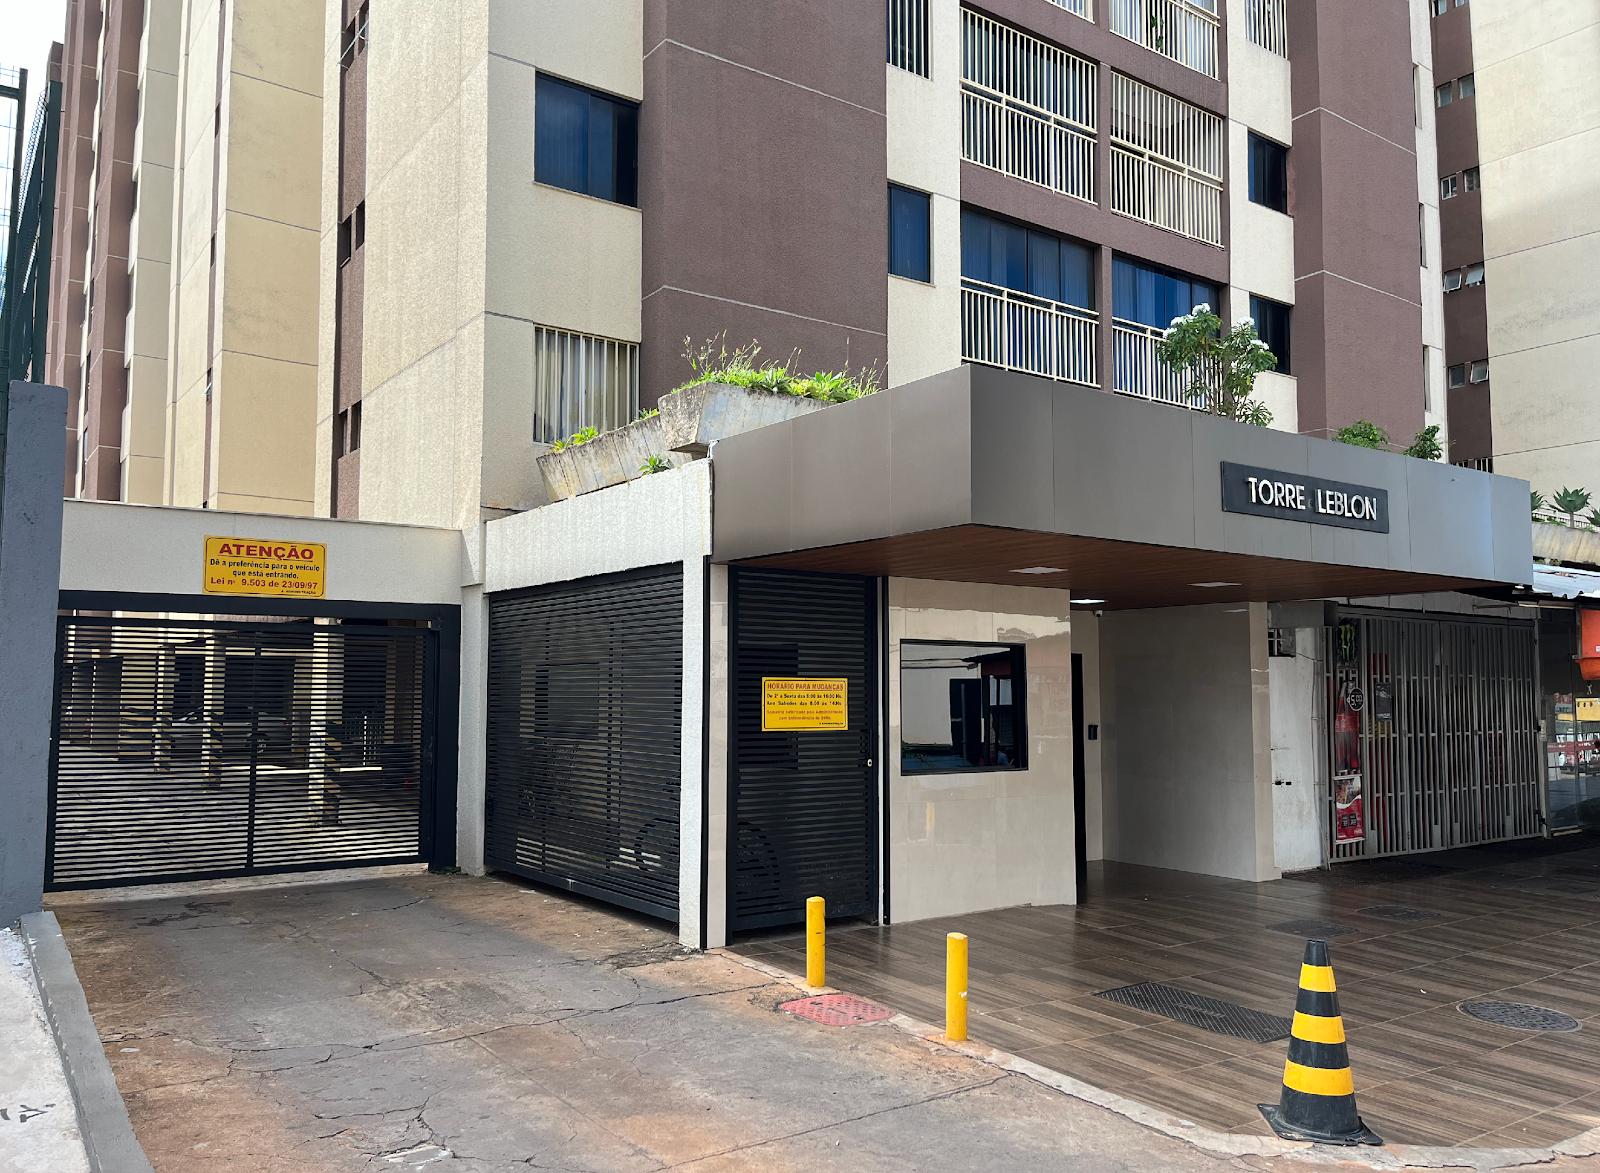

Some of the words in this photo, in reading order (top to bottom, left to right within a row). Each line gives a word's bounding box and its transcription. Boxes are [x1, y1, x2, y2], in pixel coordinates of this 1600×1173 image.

[1247, 477, 1306, 510] TORRE
[1314, 488, 1378, 521] LEBLON
[219, 544, 314, 560] ATENÇÃO
[228, 560, 270, 570] preferência
[232, 570, 246, 578] que
[265, 571, 299, 579] entrando.
[210, 577, 225, 585] Lei
[241, 578, 266, 587] 9.503
[268, 580, 280, 588] de
[281, 580, 318, 590] 23/09/97
